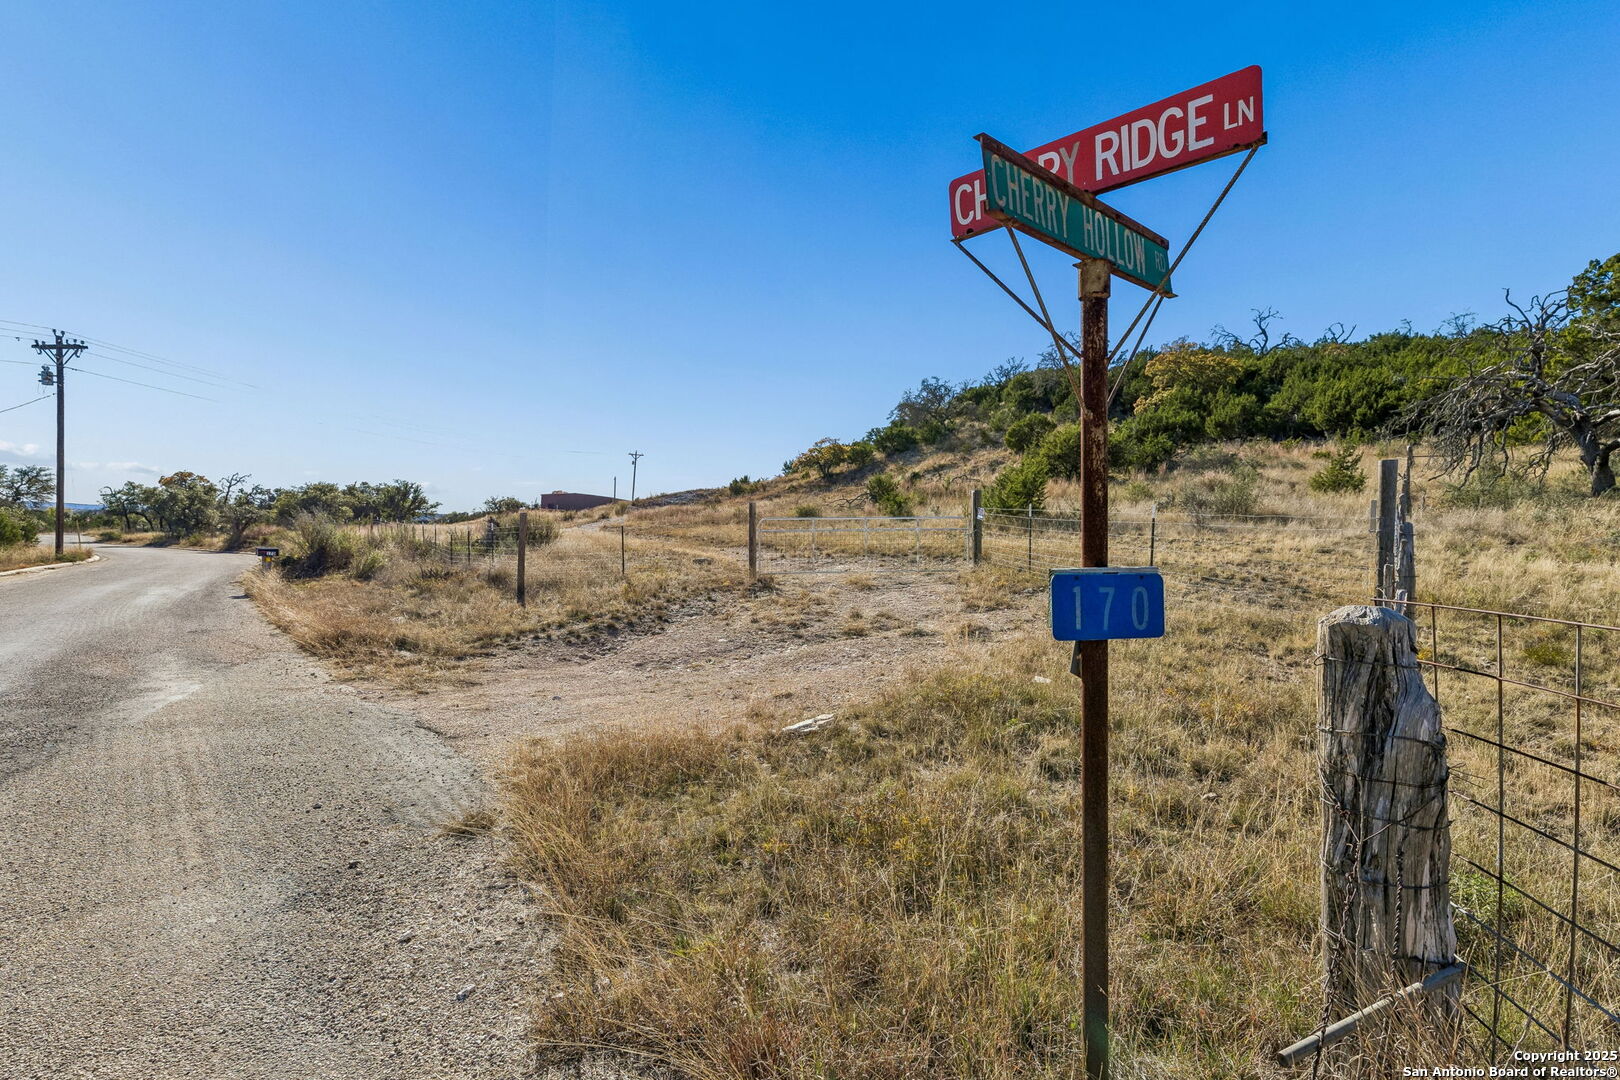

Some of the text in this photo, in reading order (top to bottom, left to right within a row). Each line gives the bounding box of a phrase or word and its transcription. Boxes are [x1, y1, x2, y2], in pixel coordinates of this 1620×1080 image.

[1095, 94, 1214, 181] RIDGE
[1223, 96, 1254, 130] LN
[990, 154, 1166, 276] CHERRY HOLLOW RD
[1072, 586, 1149, 630] 170
